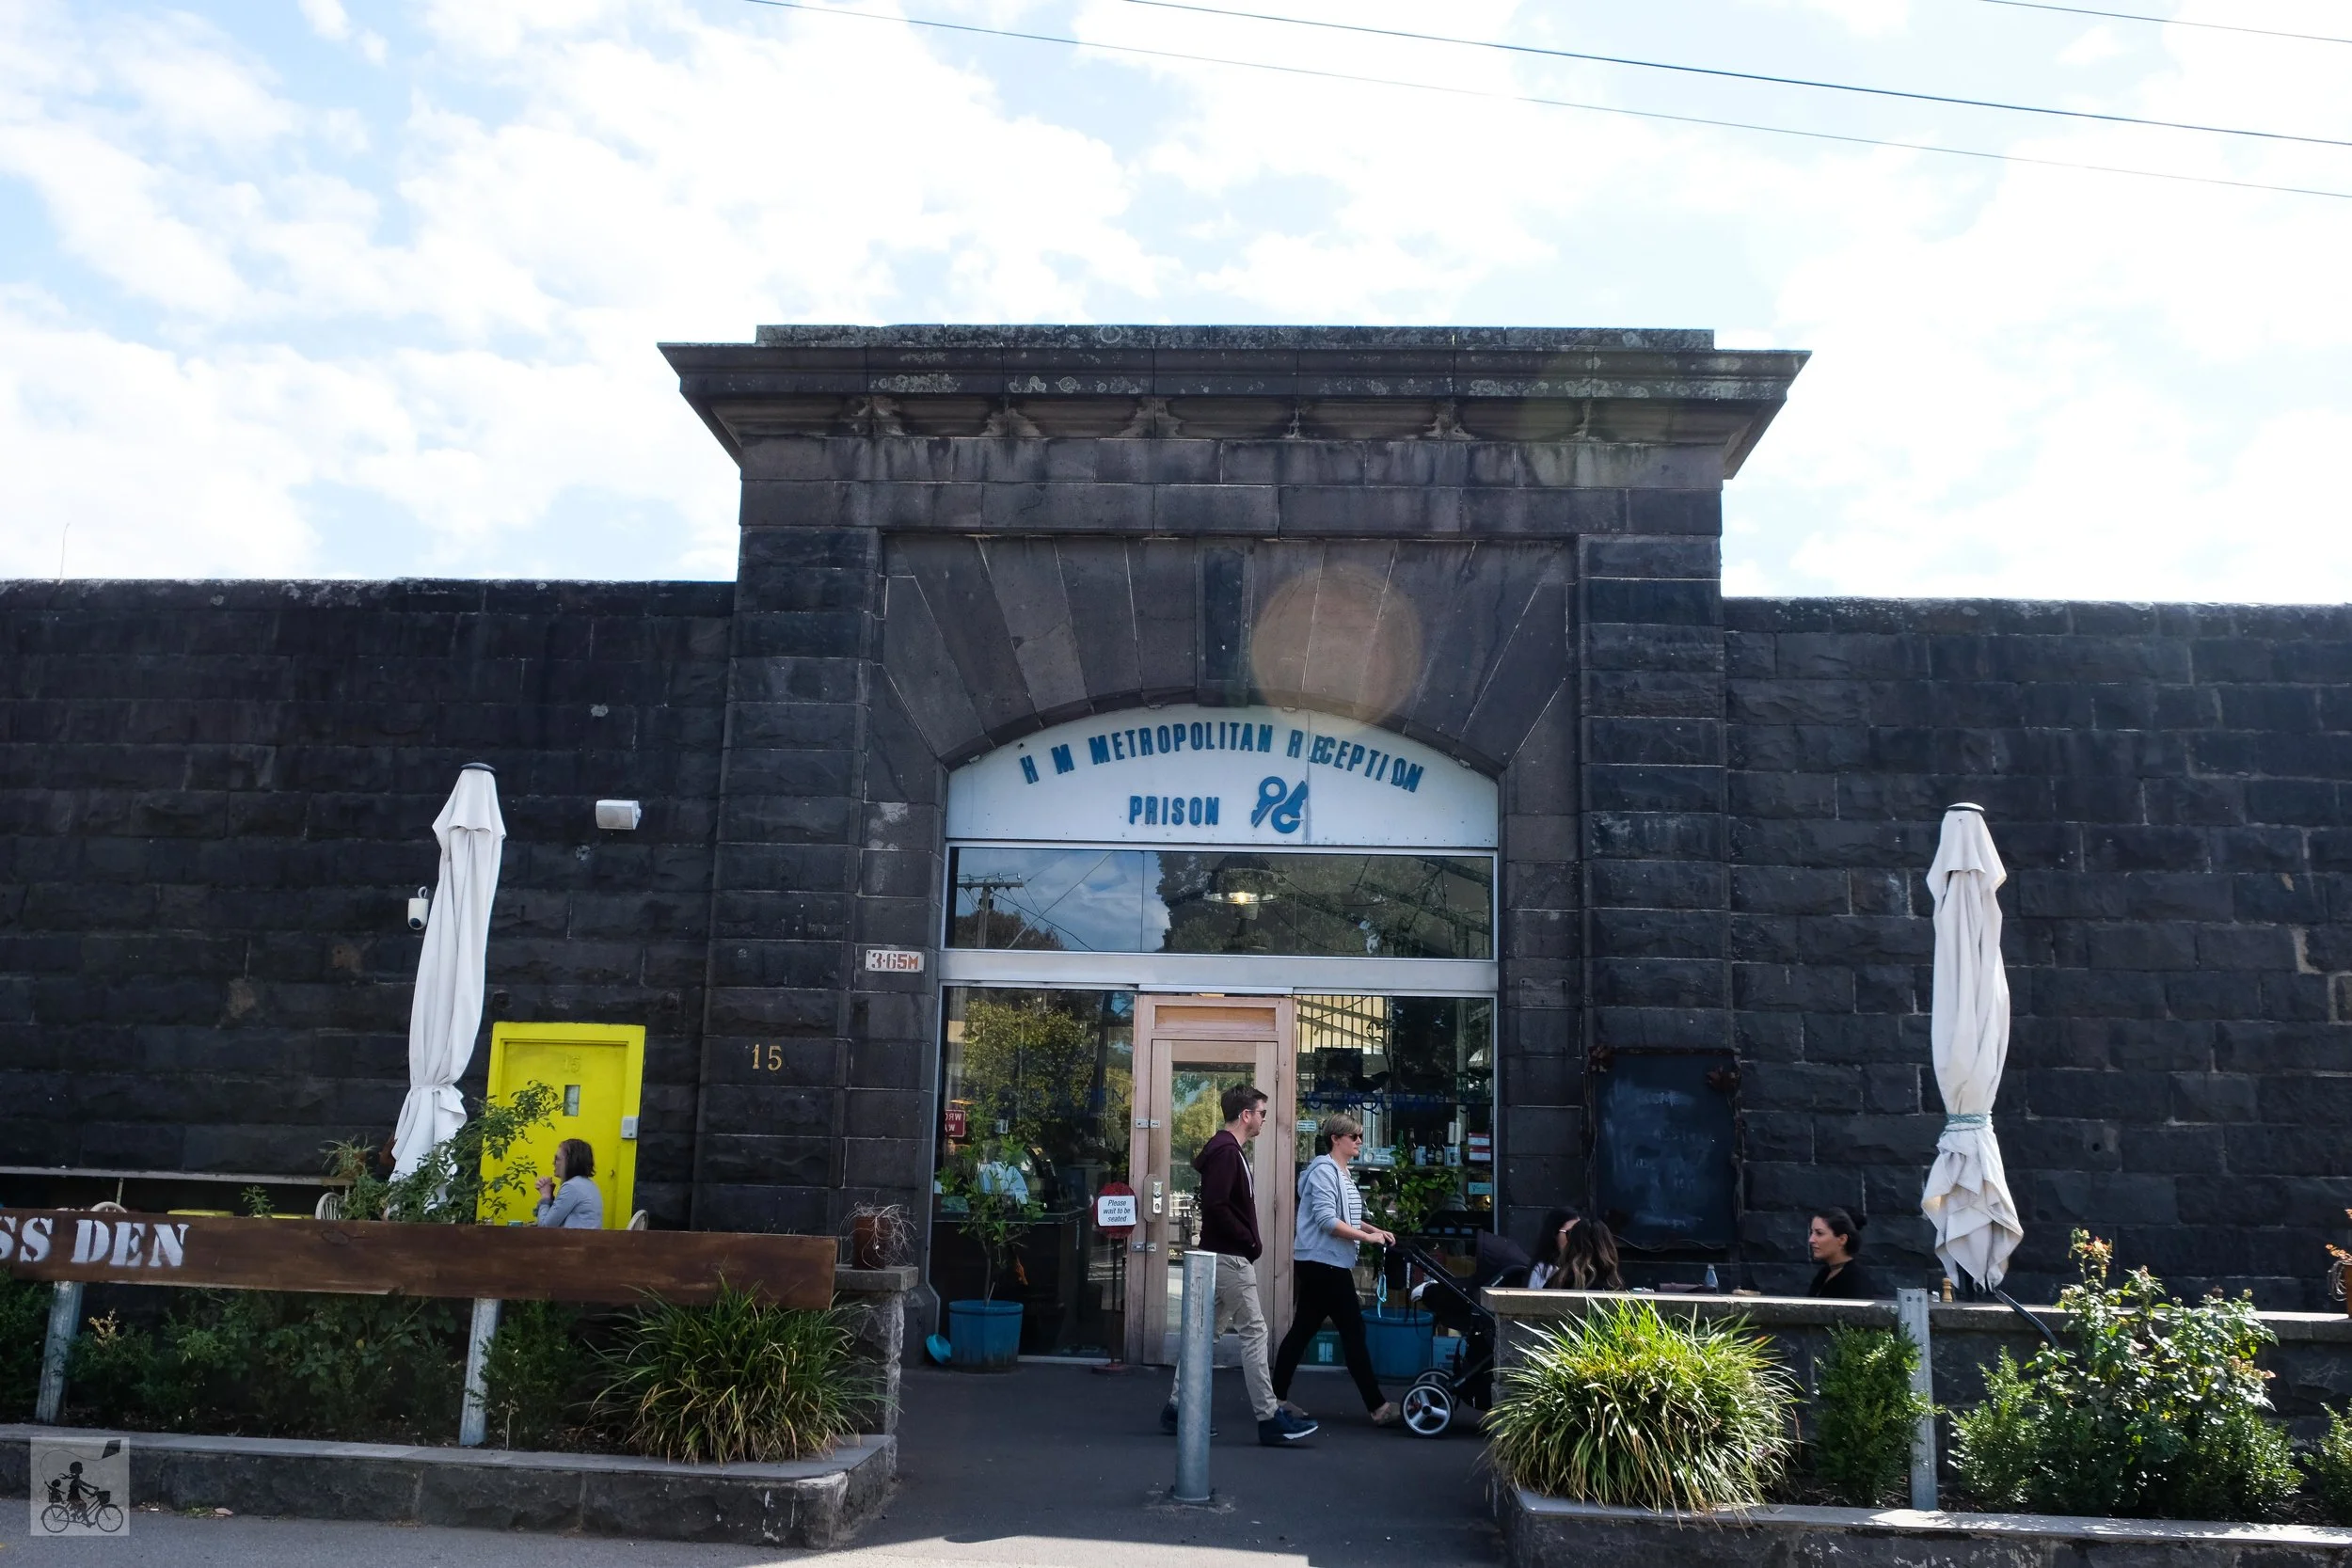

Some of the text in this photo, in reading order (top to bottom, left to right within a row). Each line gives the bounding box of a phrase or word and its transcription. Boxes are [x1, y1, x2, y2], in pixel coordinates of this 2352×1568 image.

[1019, 721, 1424, 793] H M METROPOLITAN RECEPTION
[1128, 795, 1219, 826] PRISON
[564, 1054, 581, 1073] 15
[752, 1044, 782, 1071] 15
[71, 1219, 190, 1267] DEN
